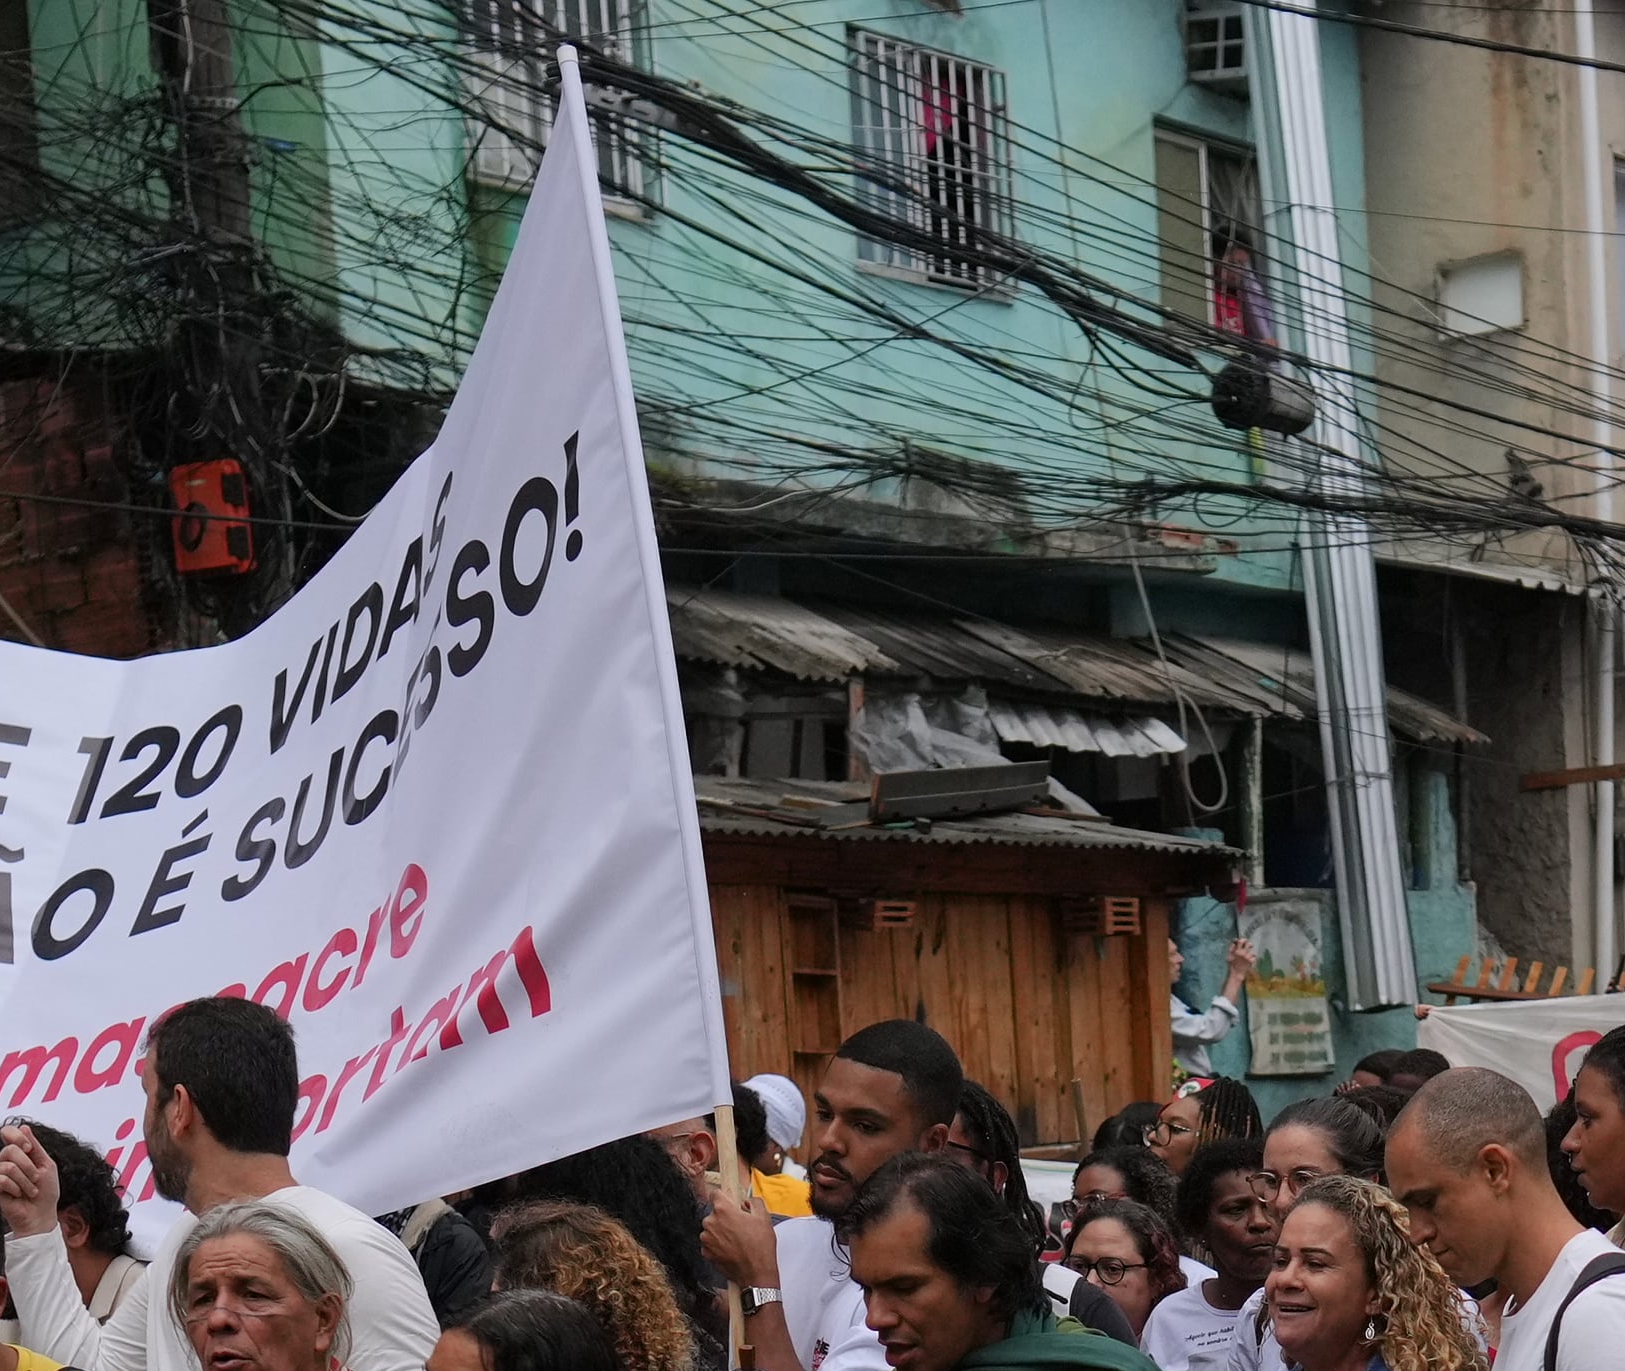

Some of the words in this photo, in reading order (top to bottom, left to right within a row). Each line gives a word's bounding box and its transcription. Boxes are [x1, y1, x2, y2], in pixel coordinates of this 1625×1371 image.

[67, 703, 244, 825] 120
[269, 469, 454, 755] VIDAS
[129, 810, 213, 938] É
